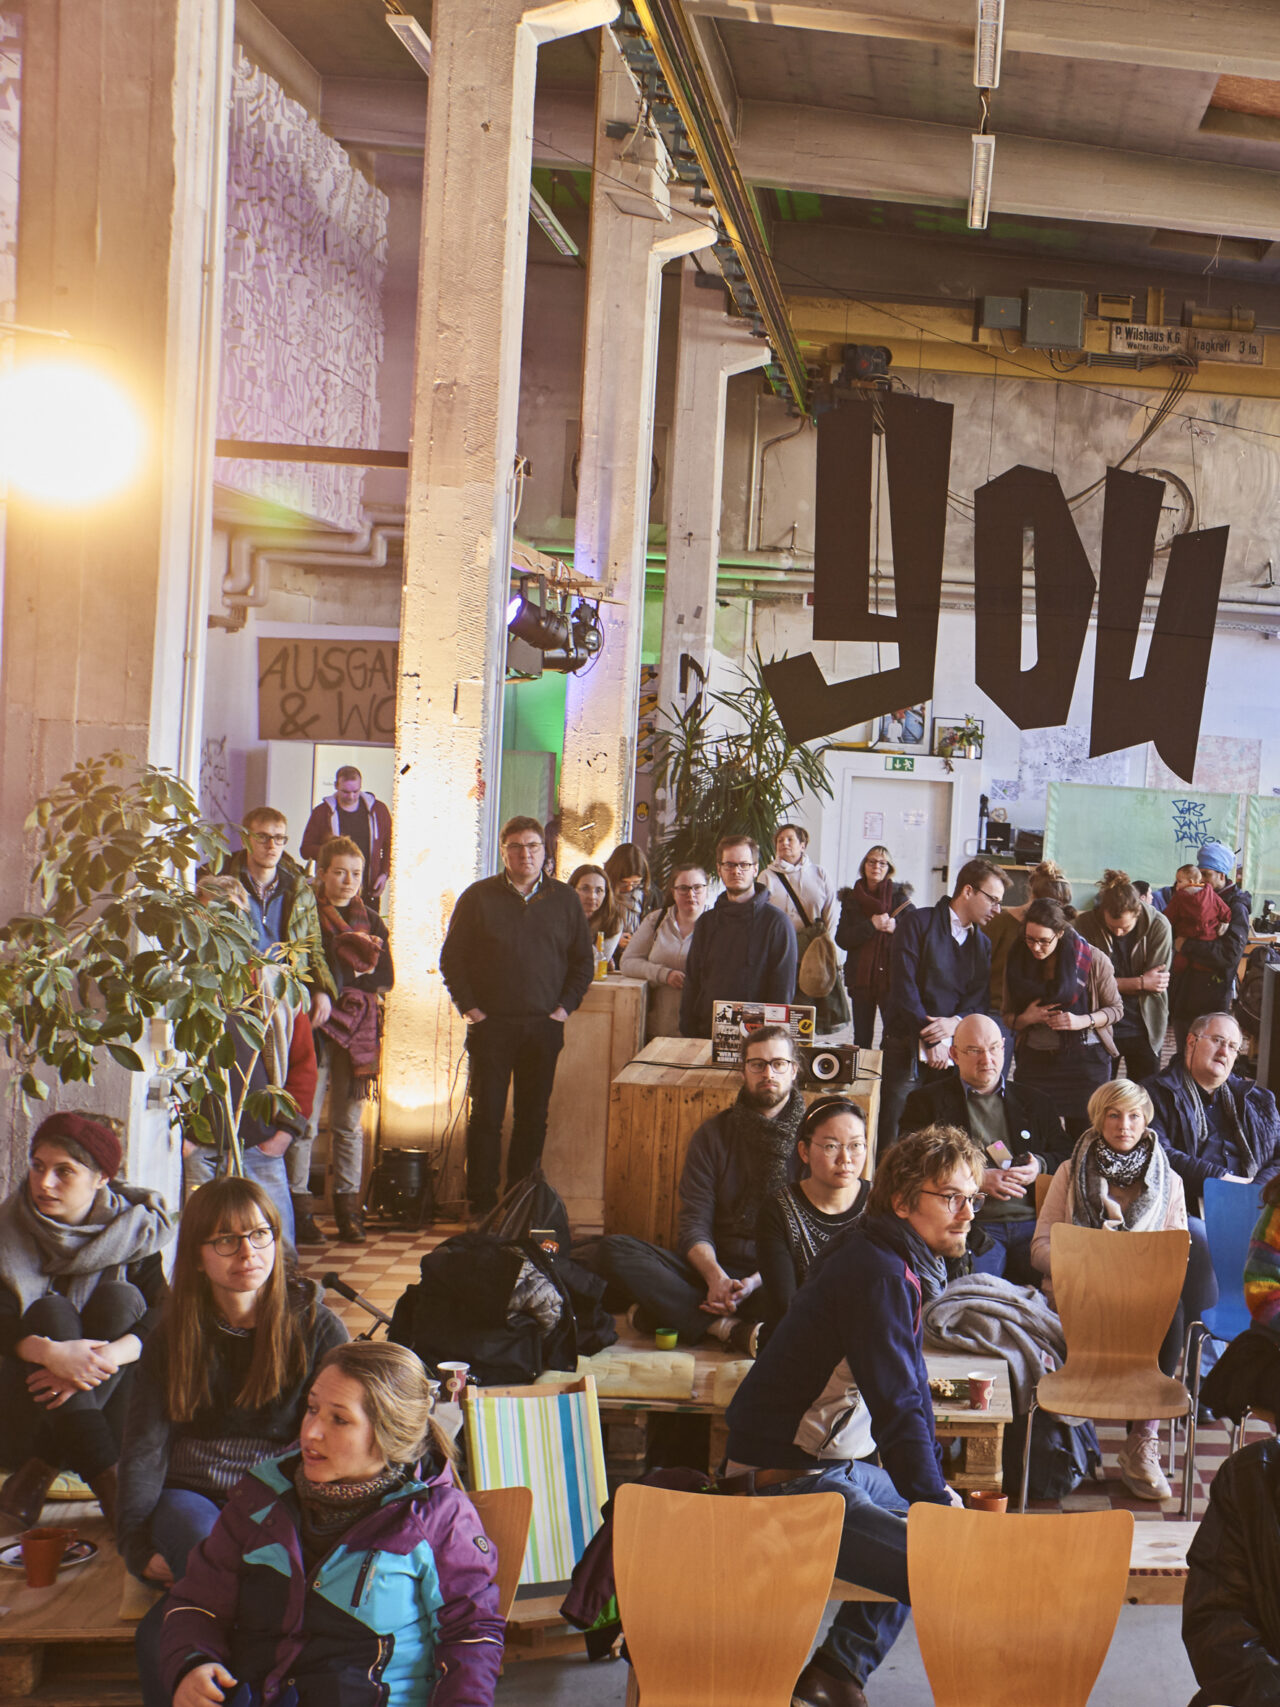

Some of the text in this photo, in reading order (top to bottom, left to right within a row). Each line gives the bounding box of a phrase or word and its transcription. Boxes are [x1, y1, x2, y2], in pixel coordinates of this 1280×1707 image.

[1115, 326, 1123, 340] P.
[1125, 327, 1164, 342] Wilshaus
[1193, 336, 1231, 353] Tragkraft
[1239, 341, 1246, 354] 3
[762, 394, 1231, 784] you
[279, 691, 321, 738] &
